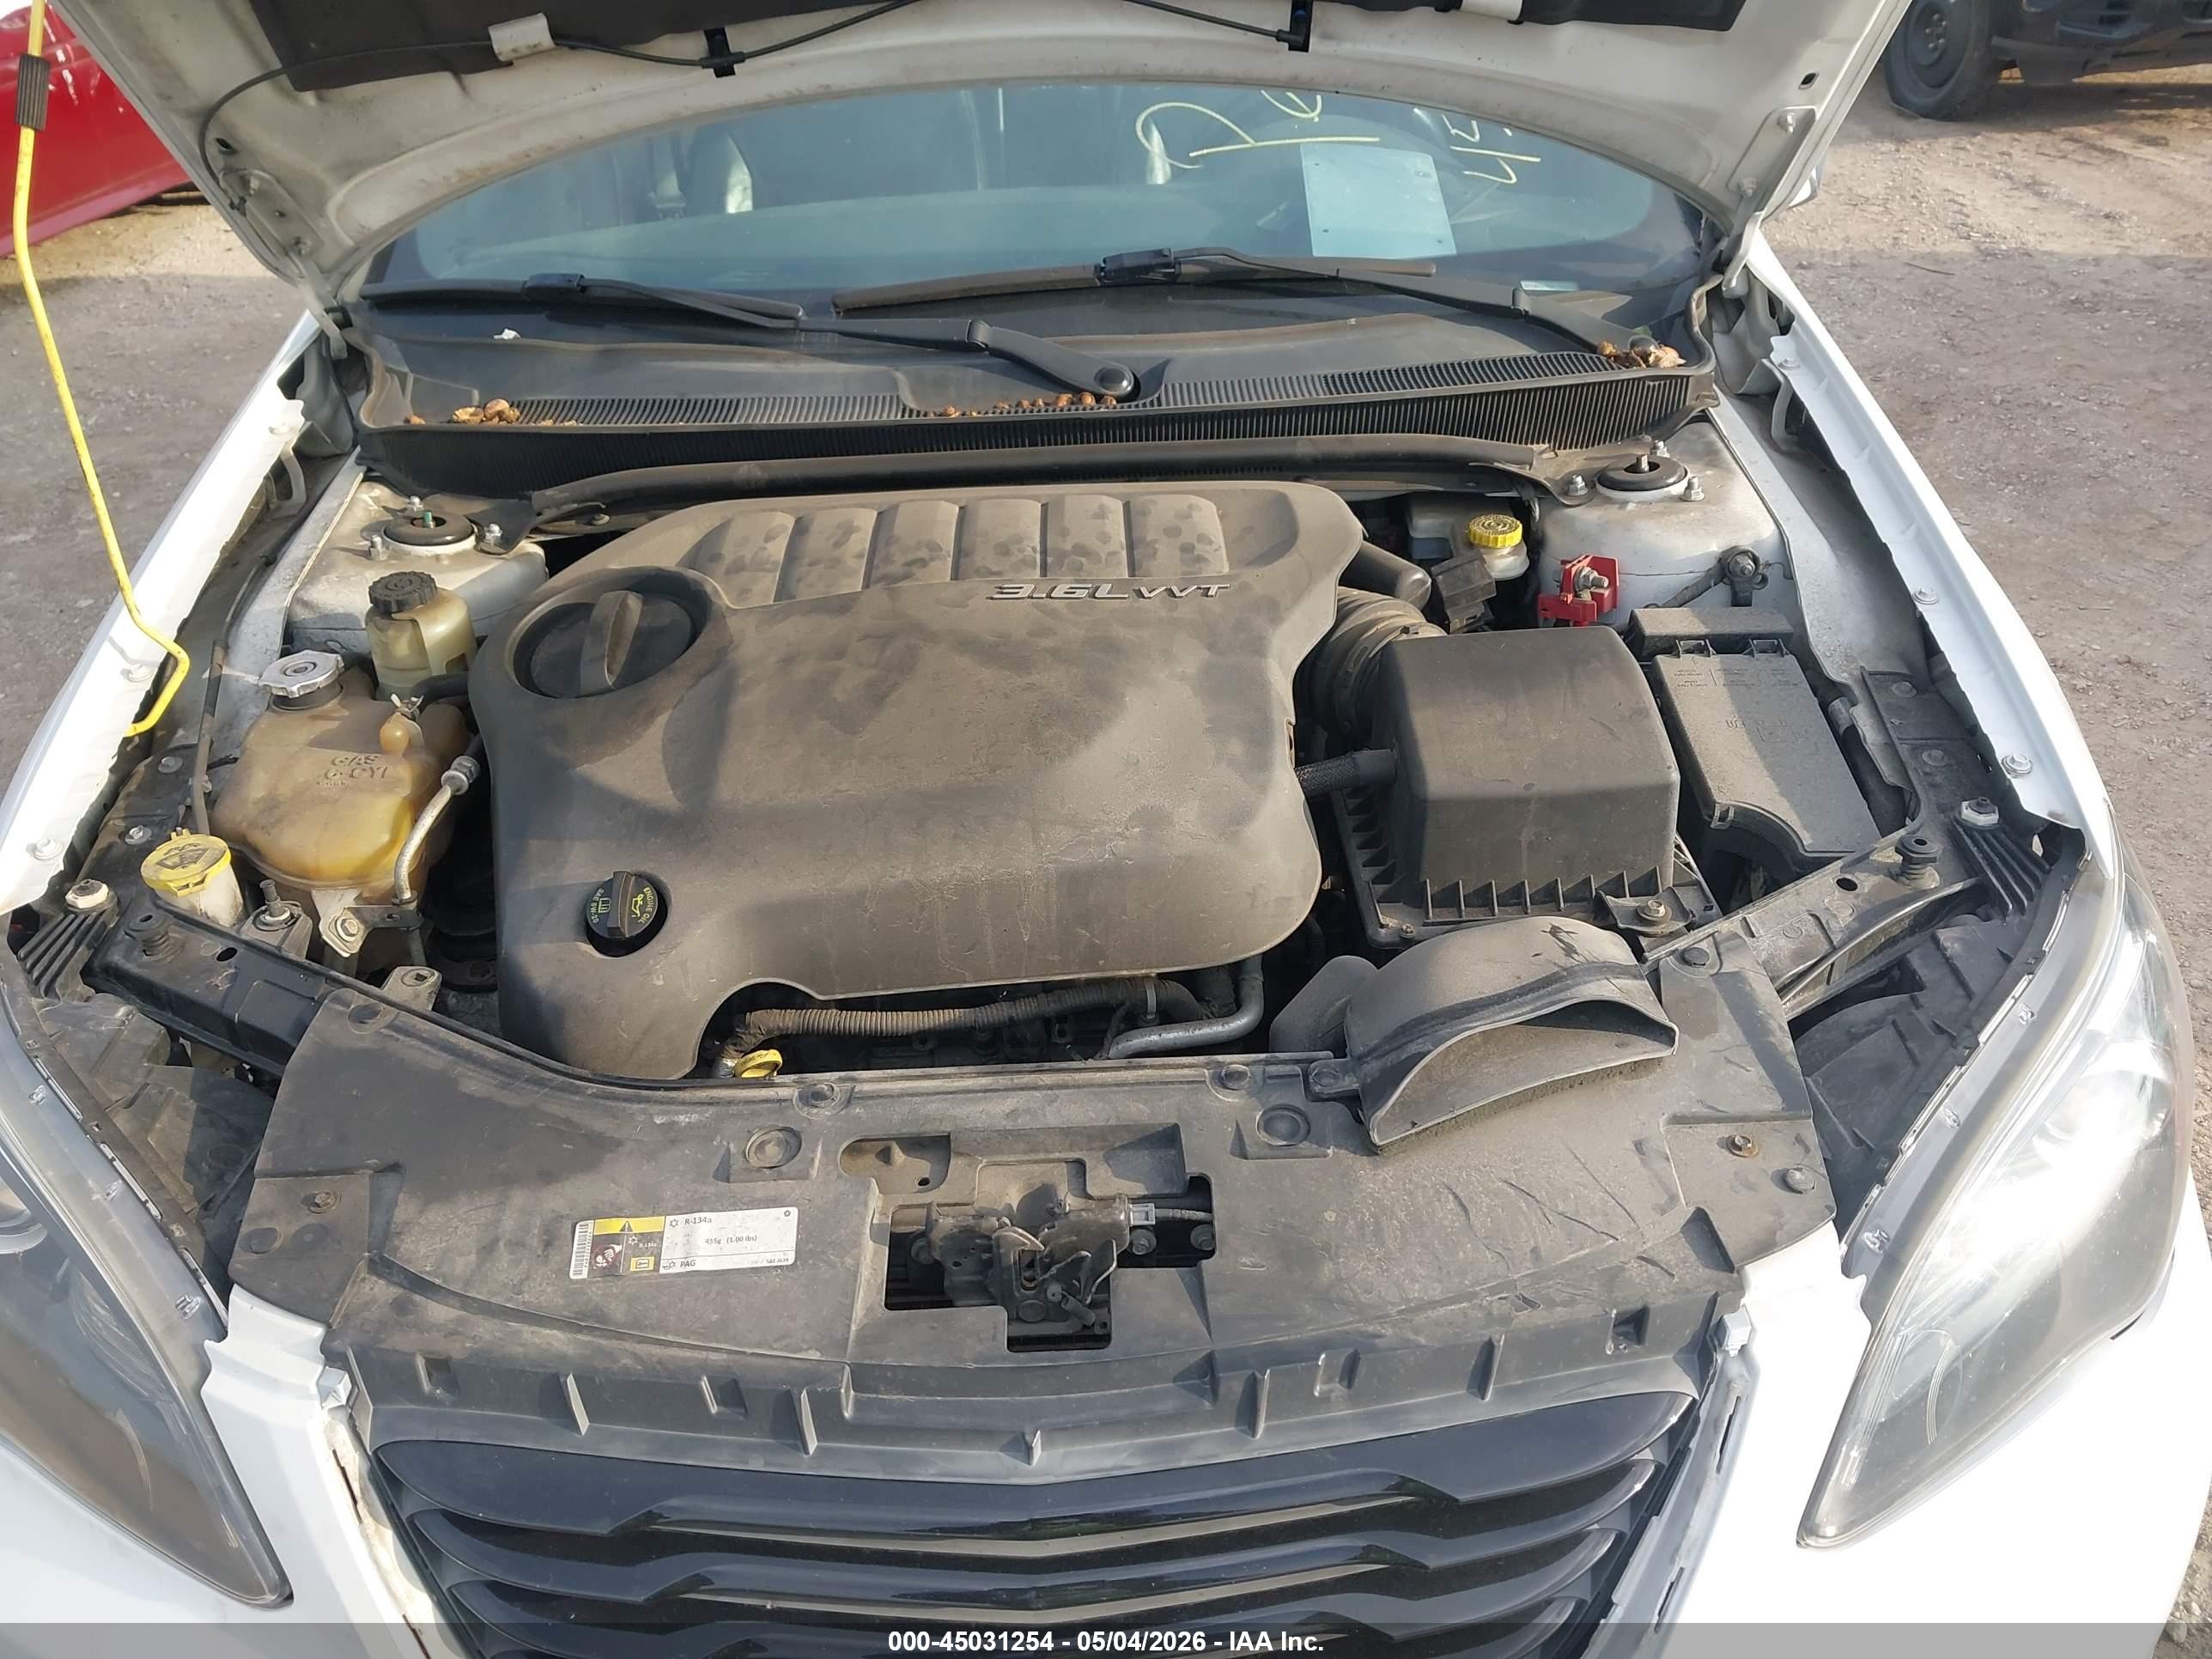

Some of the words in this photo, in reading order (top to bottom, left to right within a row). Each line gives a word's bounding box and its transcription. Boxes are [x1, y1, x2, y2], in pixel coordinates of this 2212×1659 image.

[987, 584, 1129, 600] 3.6L
[1135, 584, 1231, 599] VVT
[592, 888, 605, 902] SAE
[642, 886, 654, 913] ENGINE
[637, 913, 651, 925] OIL
[684, 1217, 712, 1225] R-134a
[680, 1260, 696, 1268] PAG
